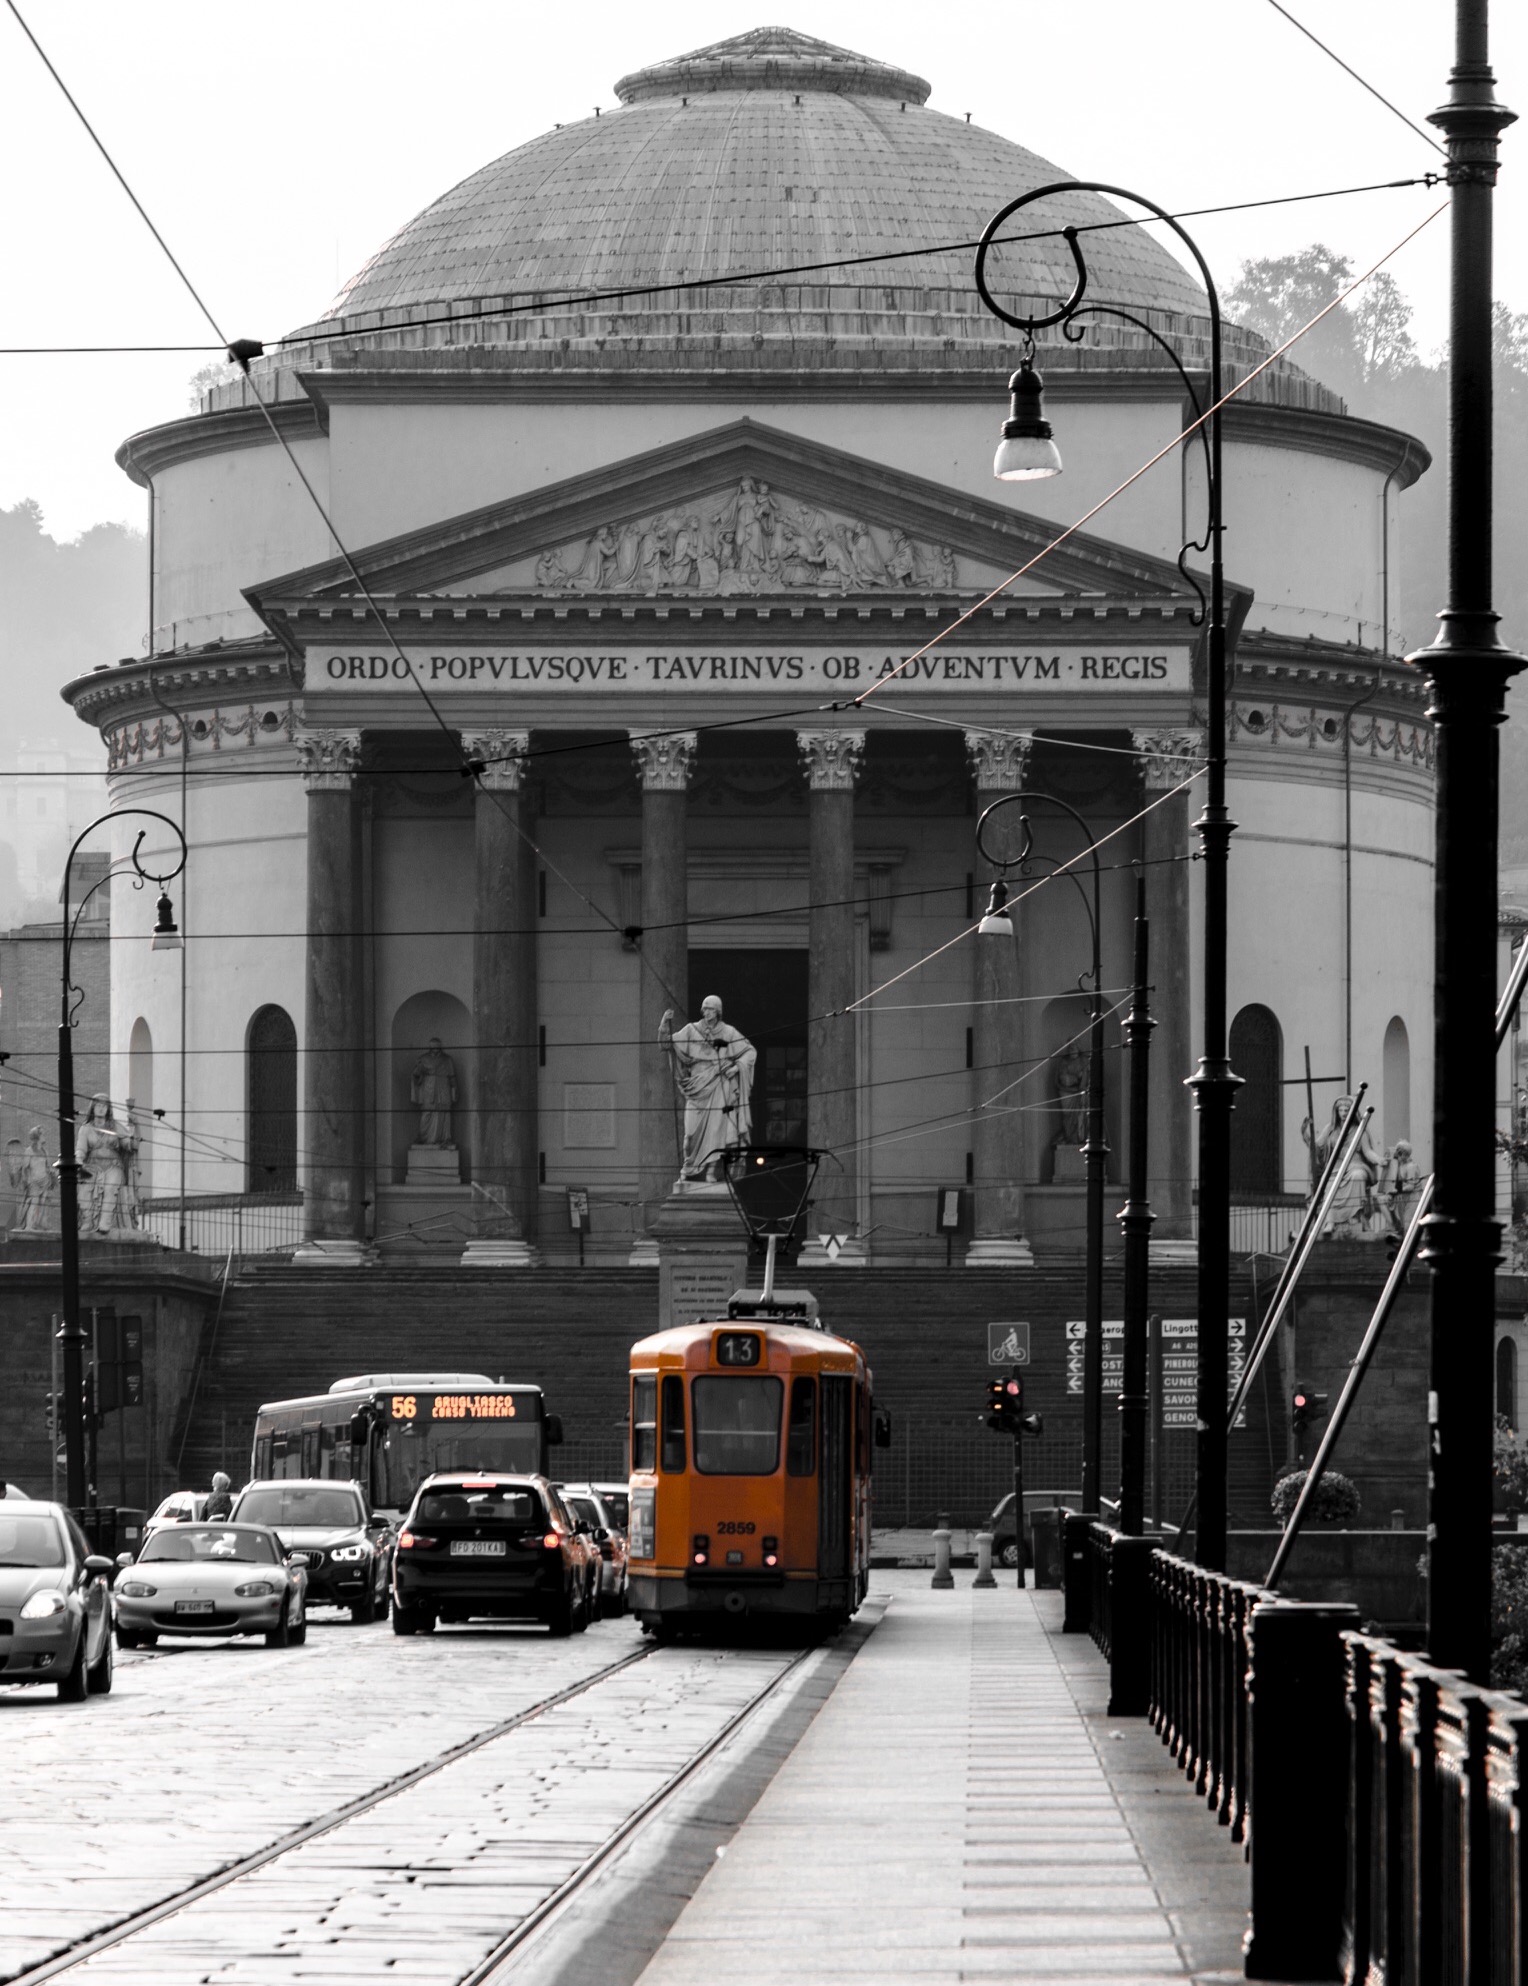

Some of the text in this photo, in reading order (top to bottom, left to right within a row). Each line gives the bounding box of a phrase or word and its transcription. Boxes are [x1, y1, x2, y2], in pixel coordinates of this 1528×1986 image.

[326, 655, 1168, 683] ORDO POPVLVSQVE TAVRINVS OB ADVENTVM REGIS
[1164, 1324, 1198, 1334] Lingott
[725, 1338, 752, 1361] 13
[1101, 1360, 1124, 1370] OST
[434, 1395, 513, 1408] GRUGLIASCO
[1164, 1395, 1198, 1405] SAVON
[391, 1396, 417, 1418] 56
[432, 1406, 466, 1418] CORSO
[717, 1521, 756, 1535] 2859
